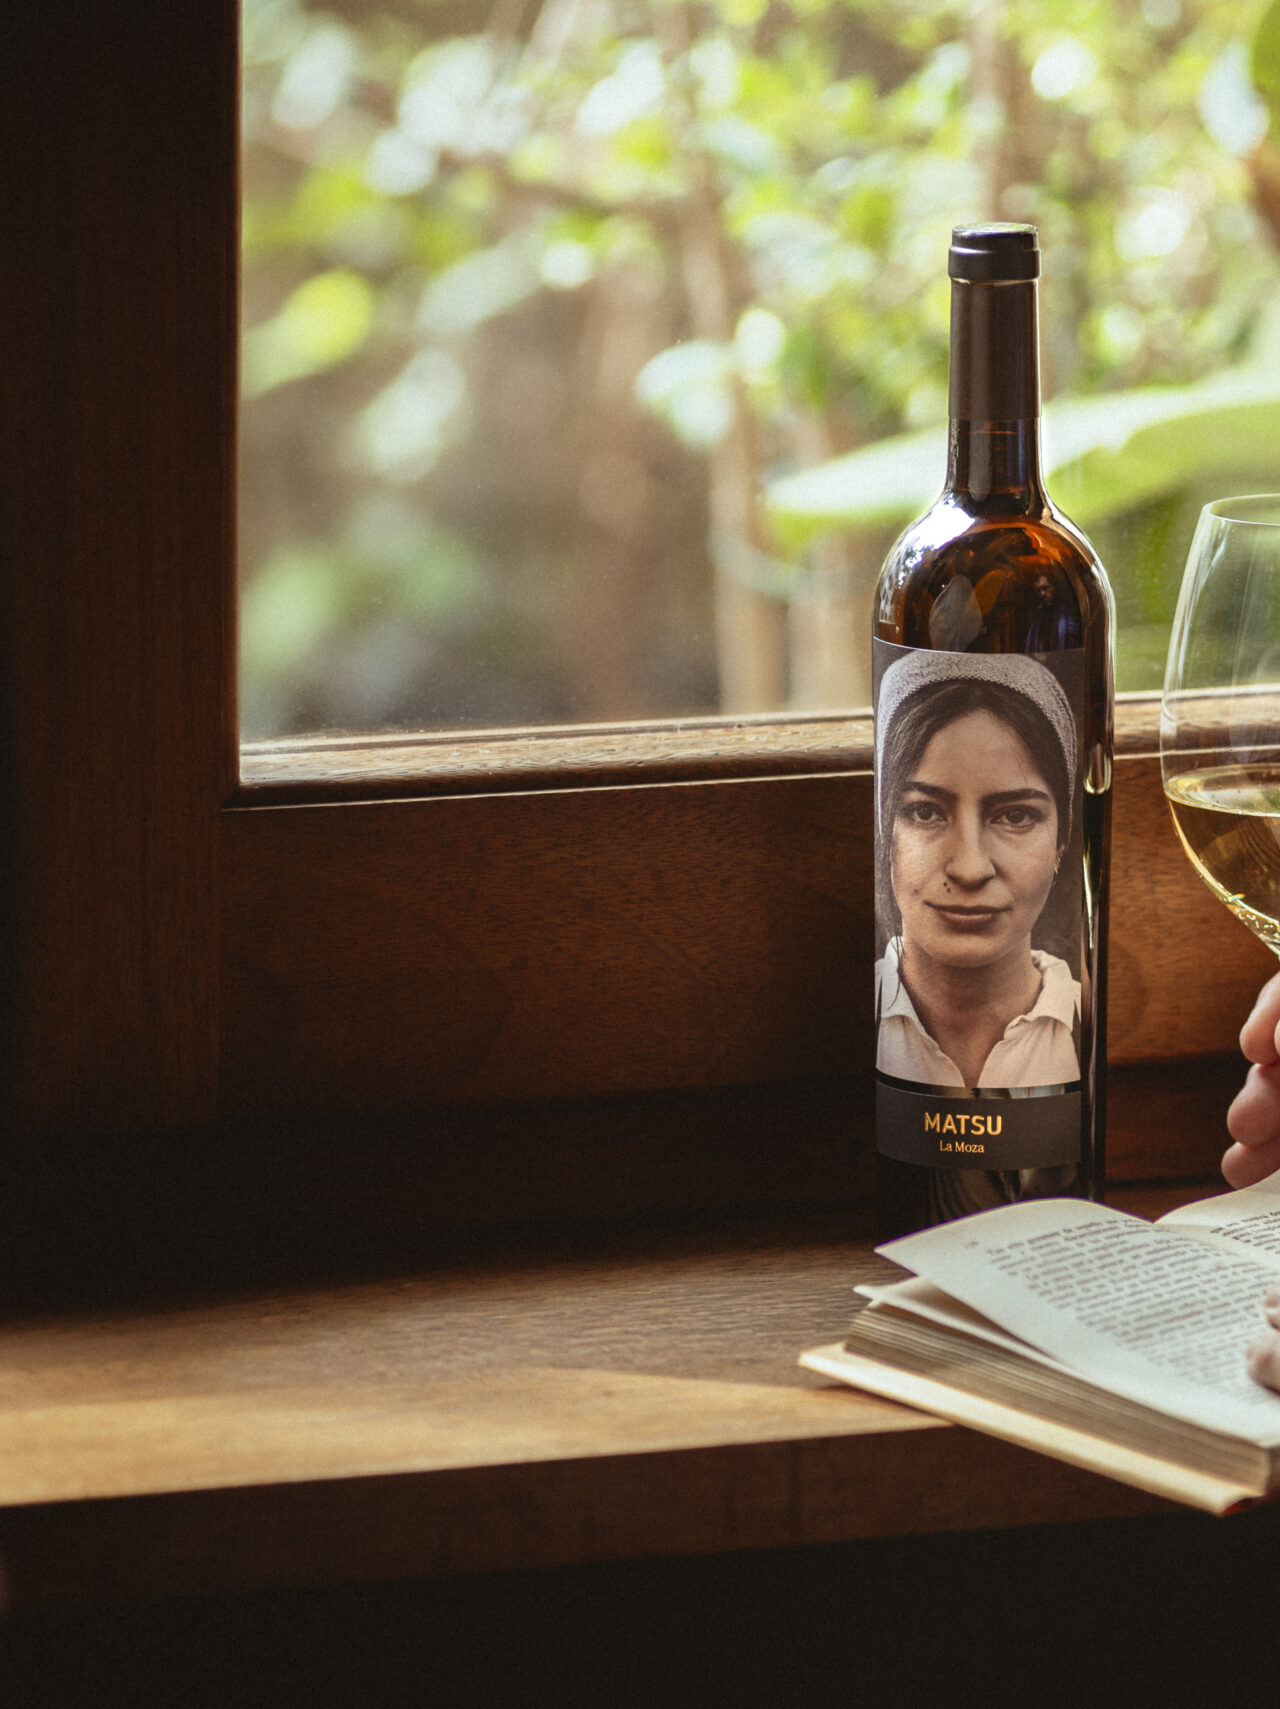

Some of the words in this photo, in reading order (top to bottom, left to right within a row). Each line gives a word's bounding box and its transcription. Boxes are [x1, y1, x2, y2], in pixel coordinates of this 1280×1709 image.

[924, 1111, 1002, 1136] MATSU
[939, 1140, 953, 1152] La
[955, 1141, 985, 1153] Moza
